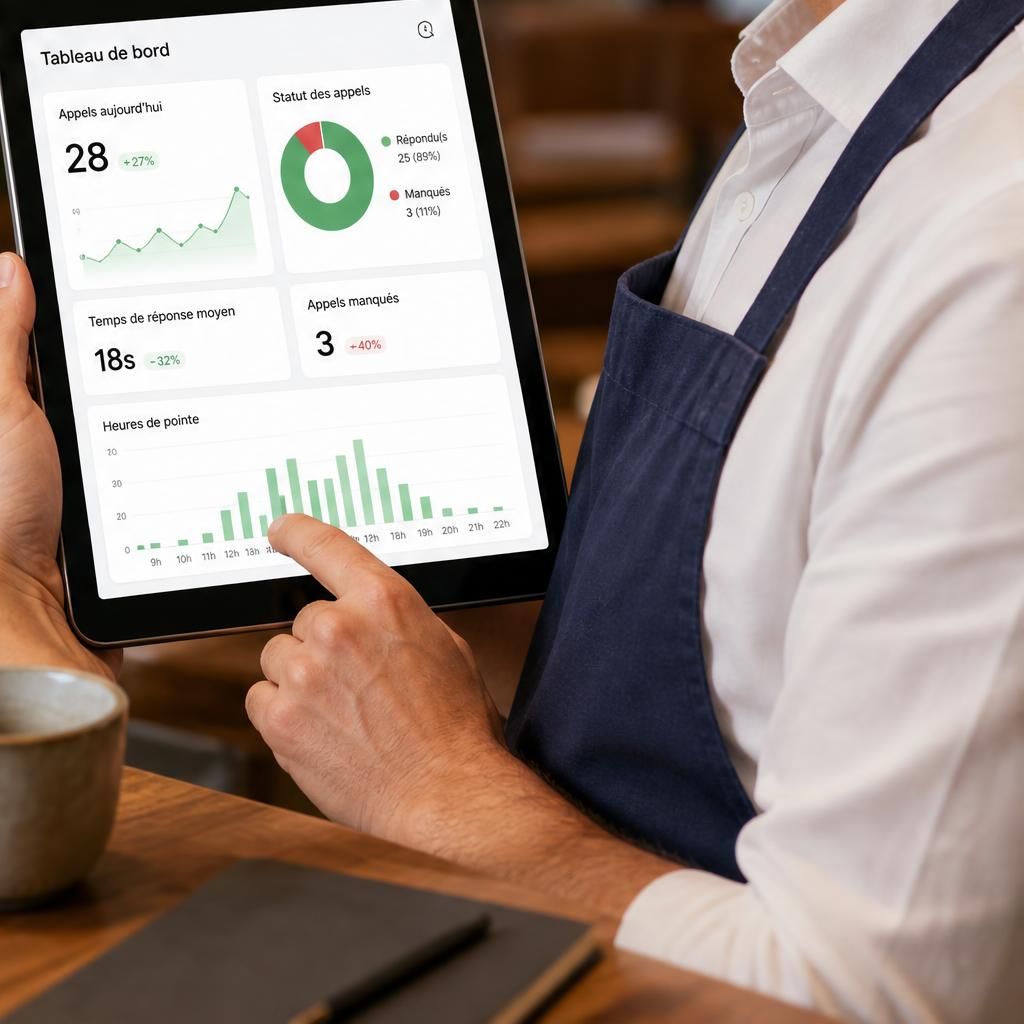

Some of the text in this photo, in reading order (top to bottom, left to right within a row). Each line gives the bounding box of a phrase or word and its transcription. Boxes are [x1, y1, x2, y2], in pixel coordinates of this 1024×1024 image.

[40, 42, 170, 66] Tableau de bord
[272, 85, 371, 103] Statut des appels
[59, 101, 163, 121] Appels aujourd'hui
[65, 141, 155, 173] 28 +27%
[397, 151, 441, 163] 25 (89%)
[404, 186, 451, 199] Manqués
[406, 205, 441, 218] 3 (11%)
[307, 292, 400, 312] Appels manqués
[88, 307, 236, 327] Temps de réponse moyen
[315, 330, 335, 357] 3
[94, 347, 181, 372] 18s -32%
[103, 414, 199, 432] Heures de pointe
[150, 557, 162, 567] 9h
[176, 554, 192, 564] 10h
[201, 552, 216, 561] 11h
[224, 549, 240, 558] 12h
[442, 525, 459, 535] 20h
[468, 522, 484, 532] 21h
[493, 519, 511, 529] 22h
